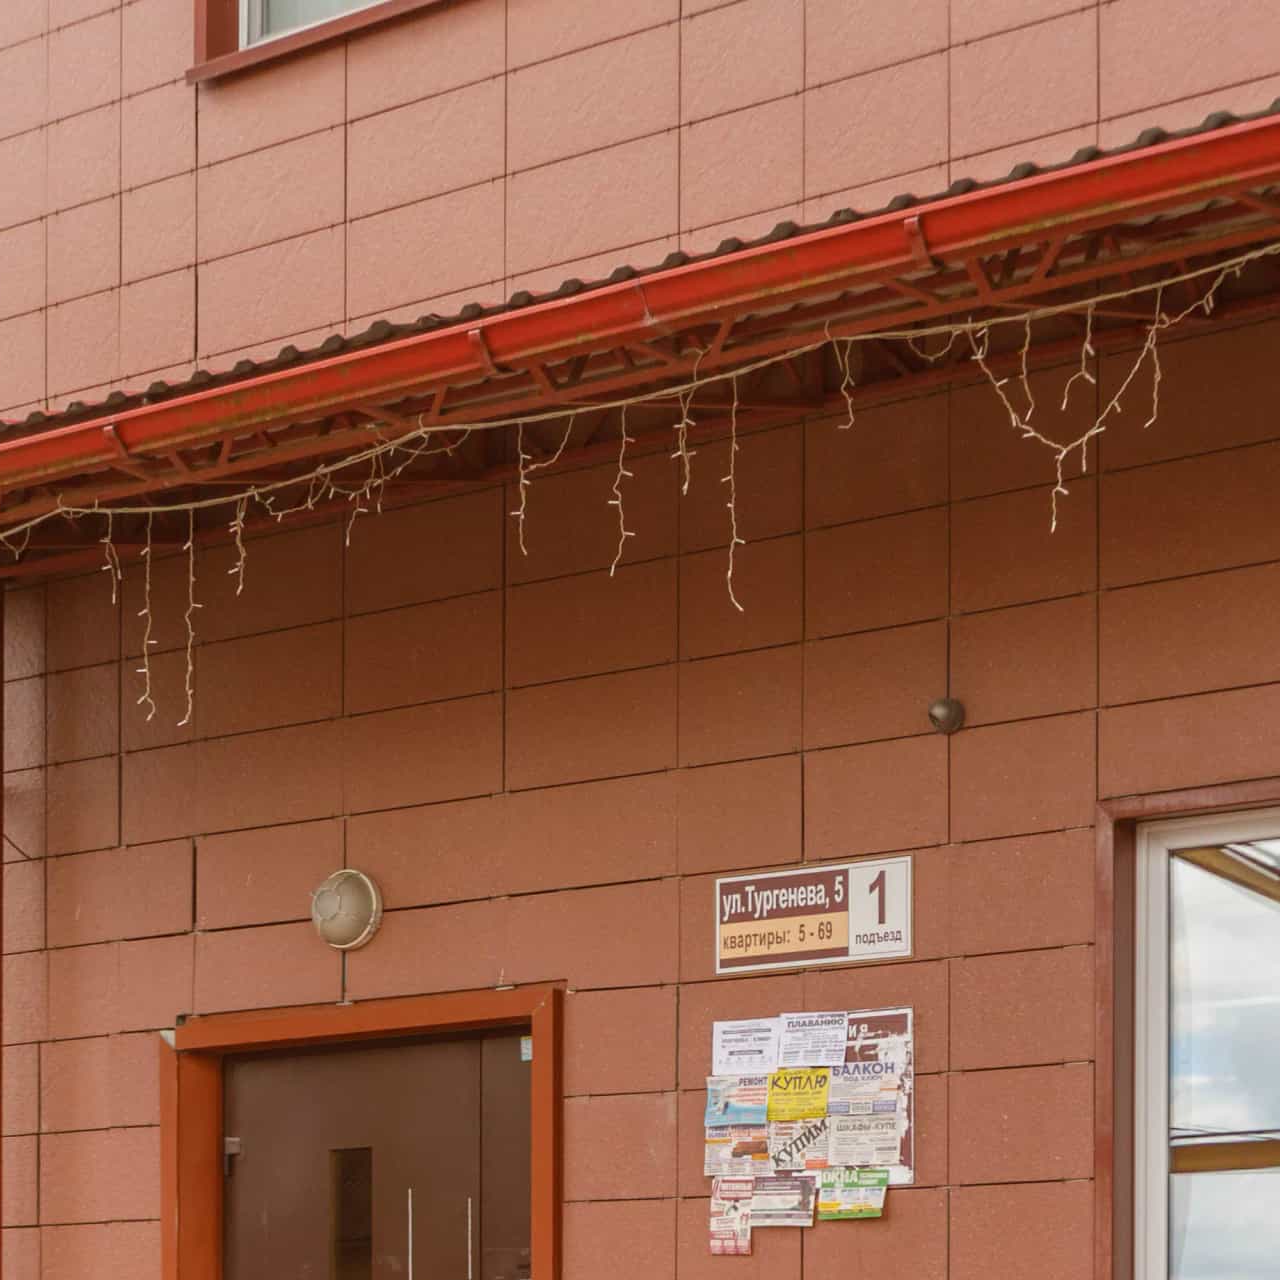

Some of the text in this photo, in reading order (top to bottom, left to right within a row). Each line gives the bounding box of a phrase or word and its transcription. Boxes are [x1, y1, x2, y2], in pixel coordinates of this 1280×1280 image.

[723, 875, 844, 922] ул.Тургенева, 5
[869, 870, 886, 924] 1
[723, 929, 791, 952] квартиры:
[798, 924, 806, 942] 5
[818, 921, 833, 940] 69
[855, 930, 903, 946] подъезд
[771, 1074, 828, 1091] КУПЛЮ
[831, 1062, 895, 1077] БАЛКОН
[771, 1118, 829, 1168] КУПИМ
